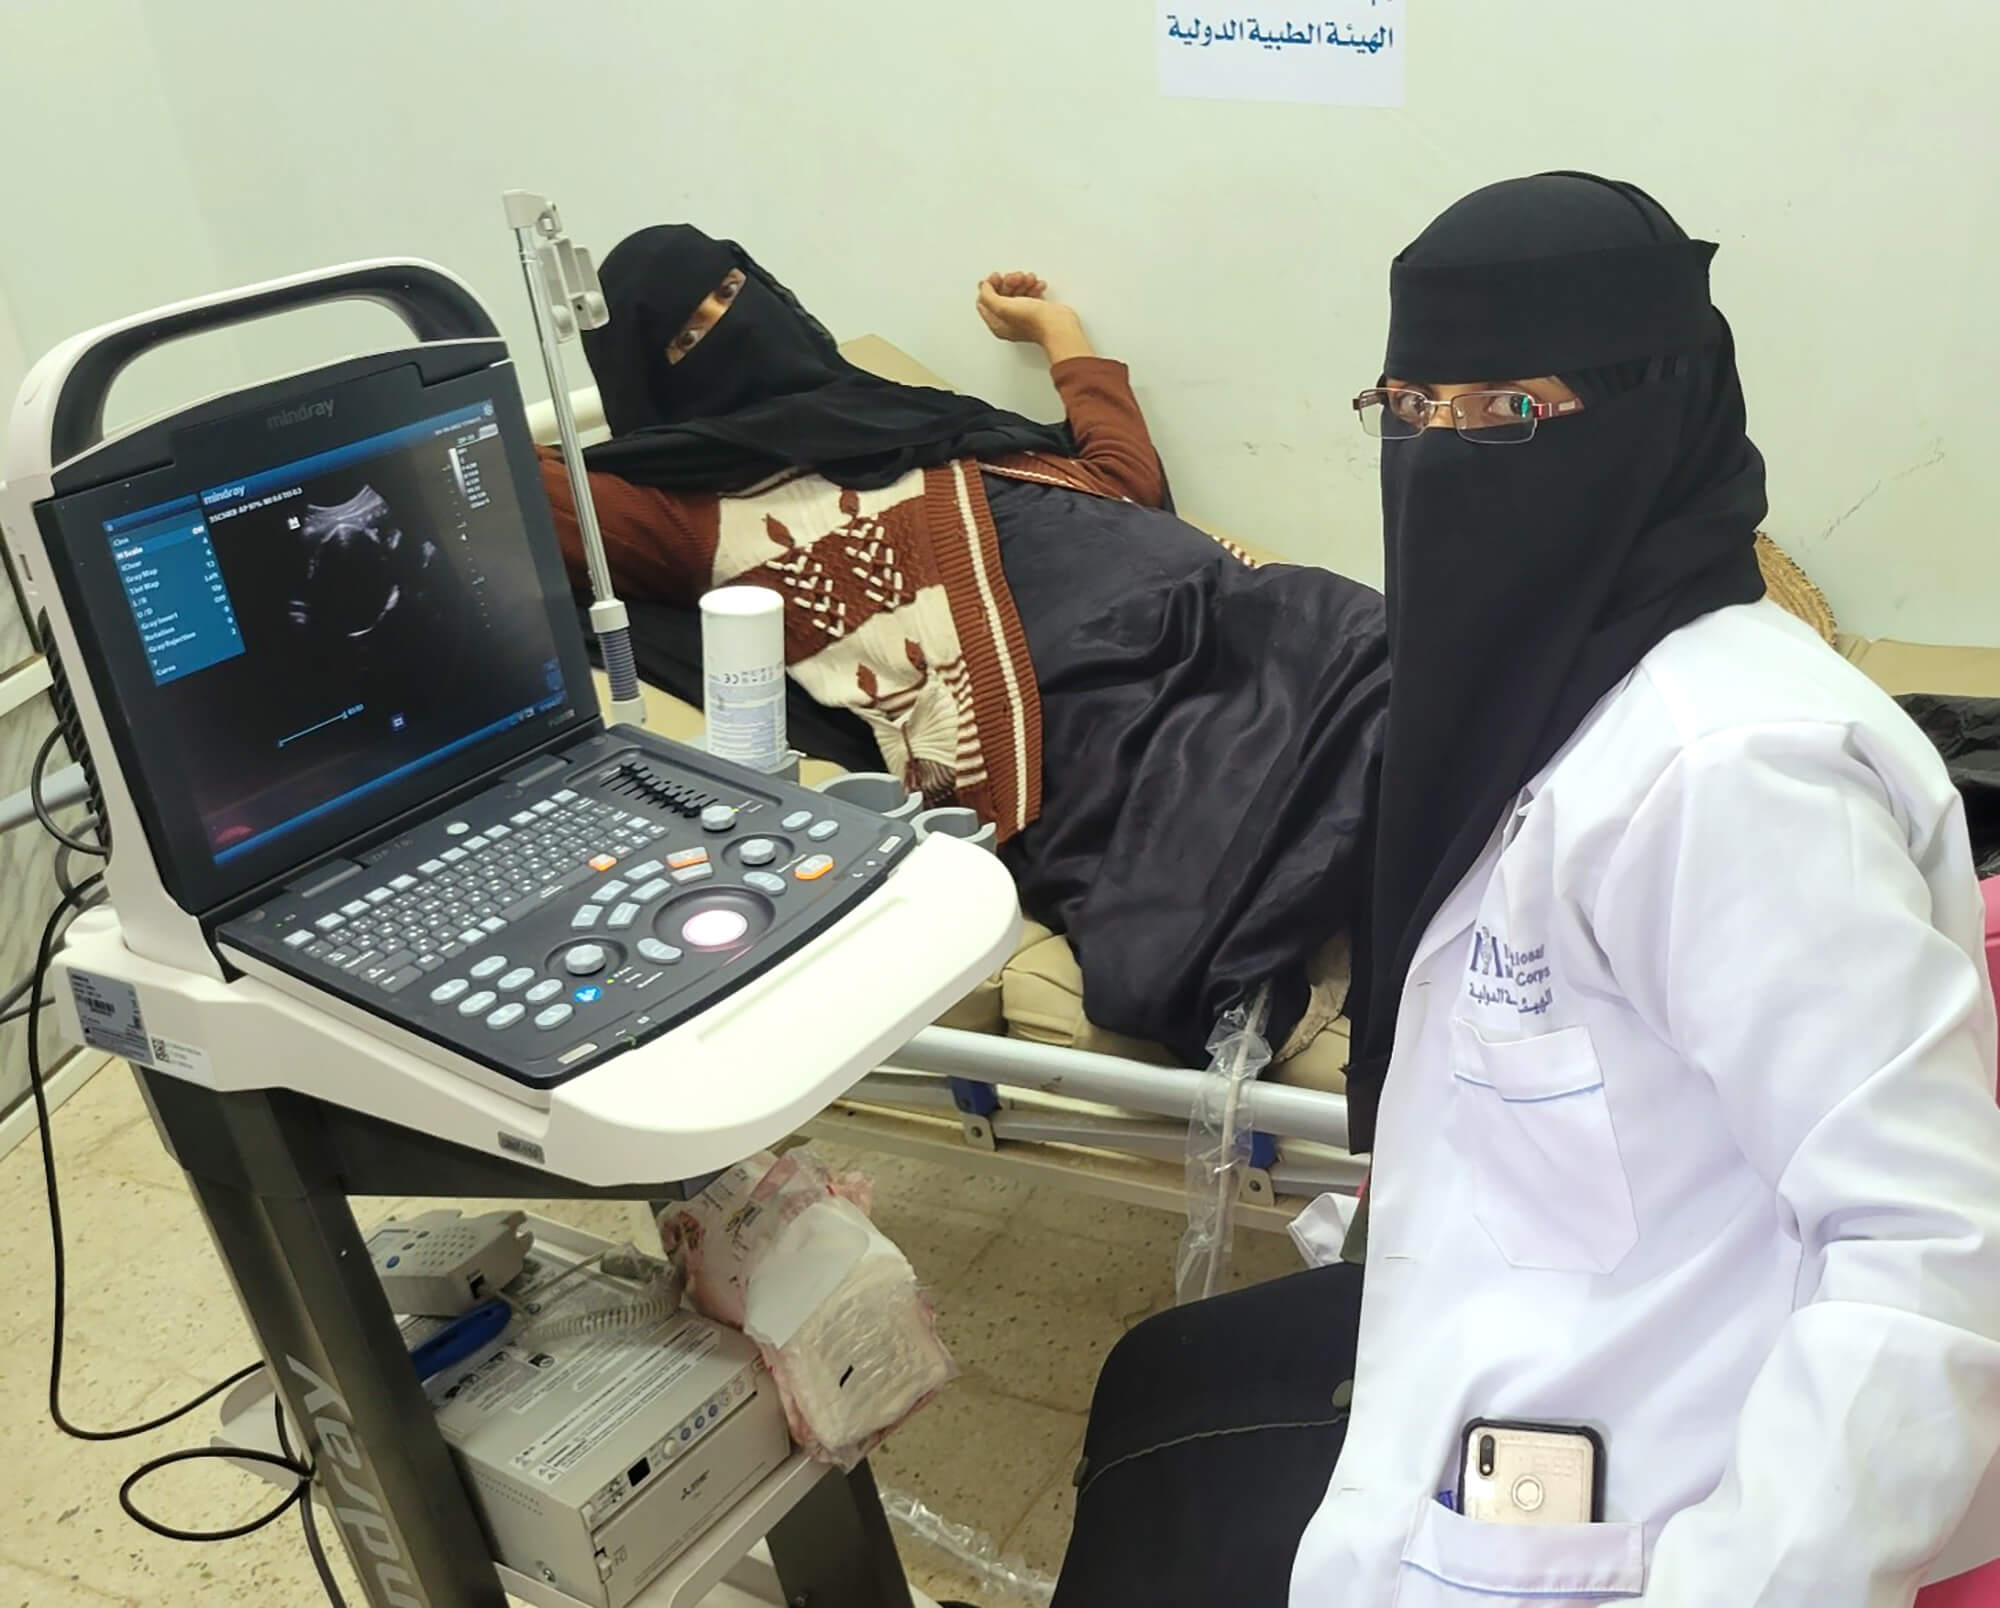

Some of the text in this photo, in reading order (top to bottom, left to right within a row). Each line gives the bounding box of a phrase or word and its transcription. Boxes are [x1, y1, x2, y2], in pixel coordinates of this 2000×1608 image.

[1167, 15, 1394, 54] الهيئة الطبية الدولية
[203, 485, 246, 505] mindray
[1515, 965, 1551, 987] Corps
